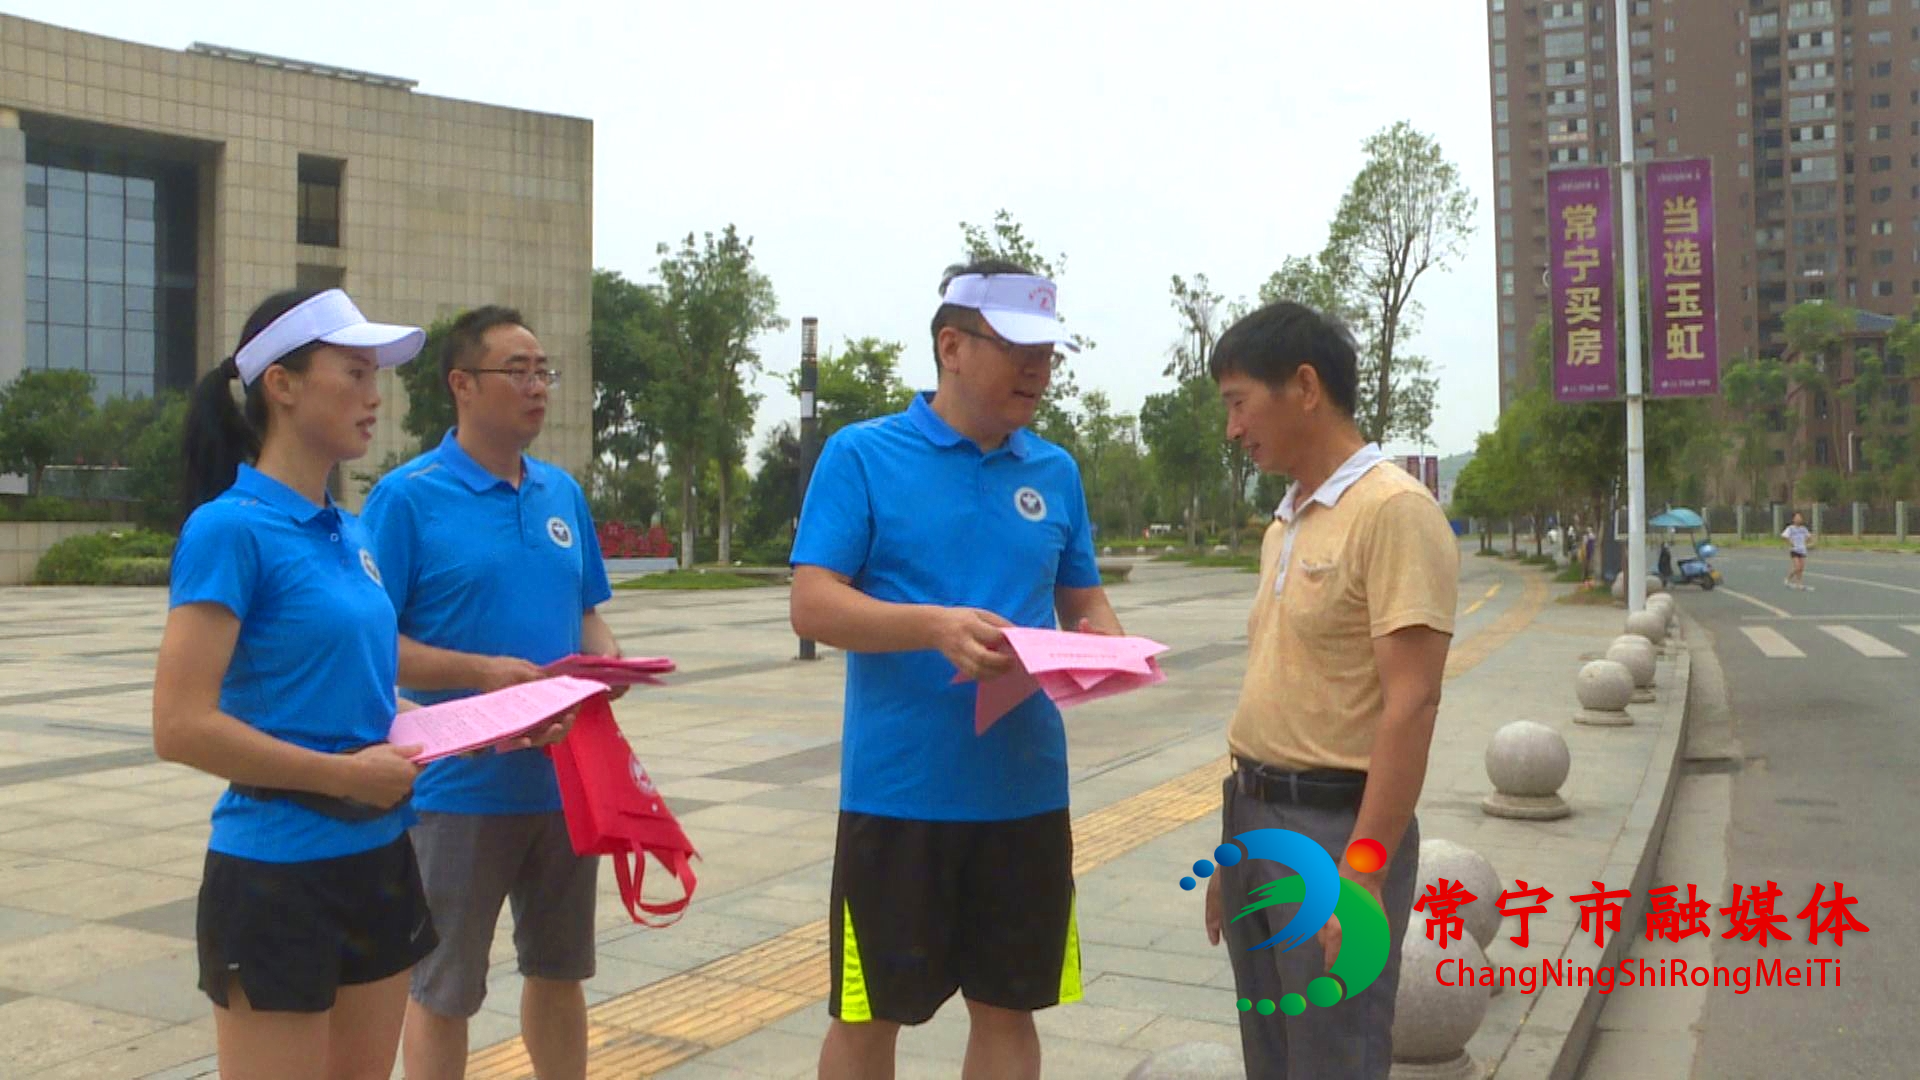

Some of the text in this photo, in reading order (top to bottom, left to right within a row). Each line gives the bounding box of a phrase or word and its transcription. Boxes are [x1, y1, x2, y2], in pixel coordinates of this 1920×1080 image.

[1562, 203, 1603, 367] 常宁买房
[1663, 195, 1705, 361] 当选玉虹
